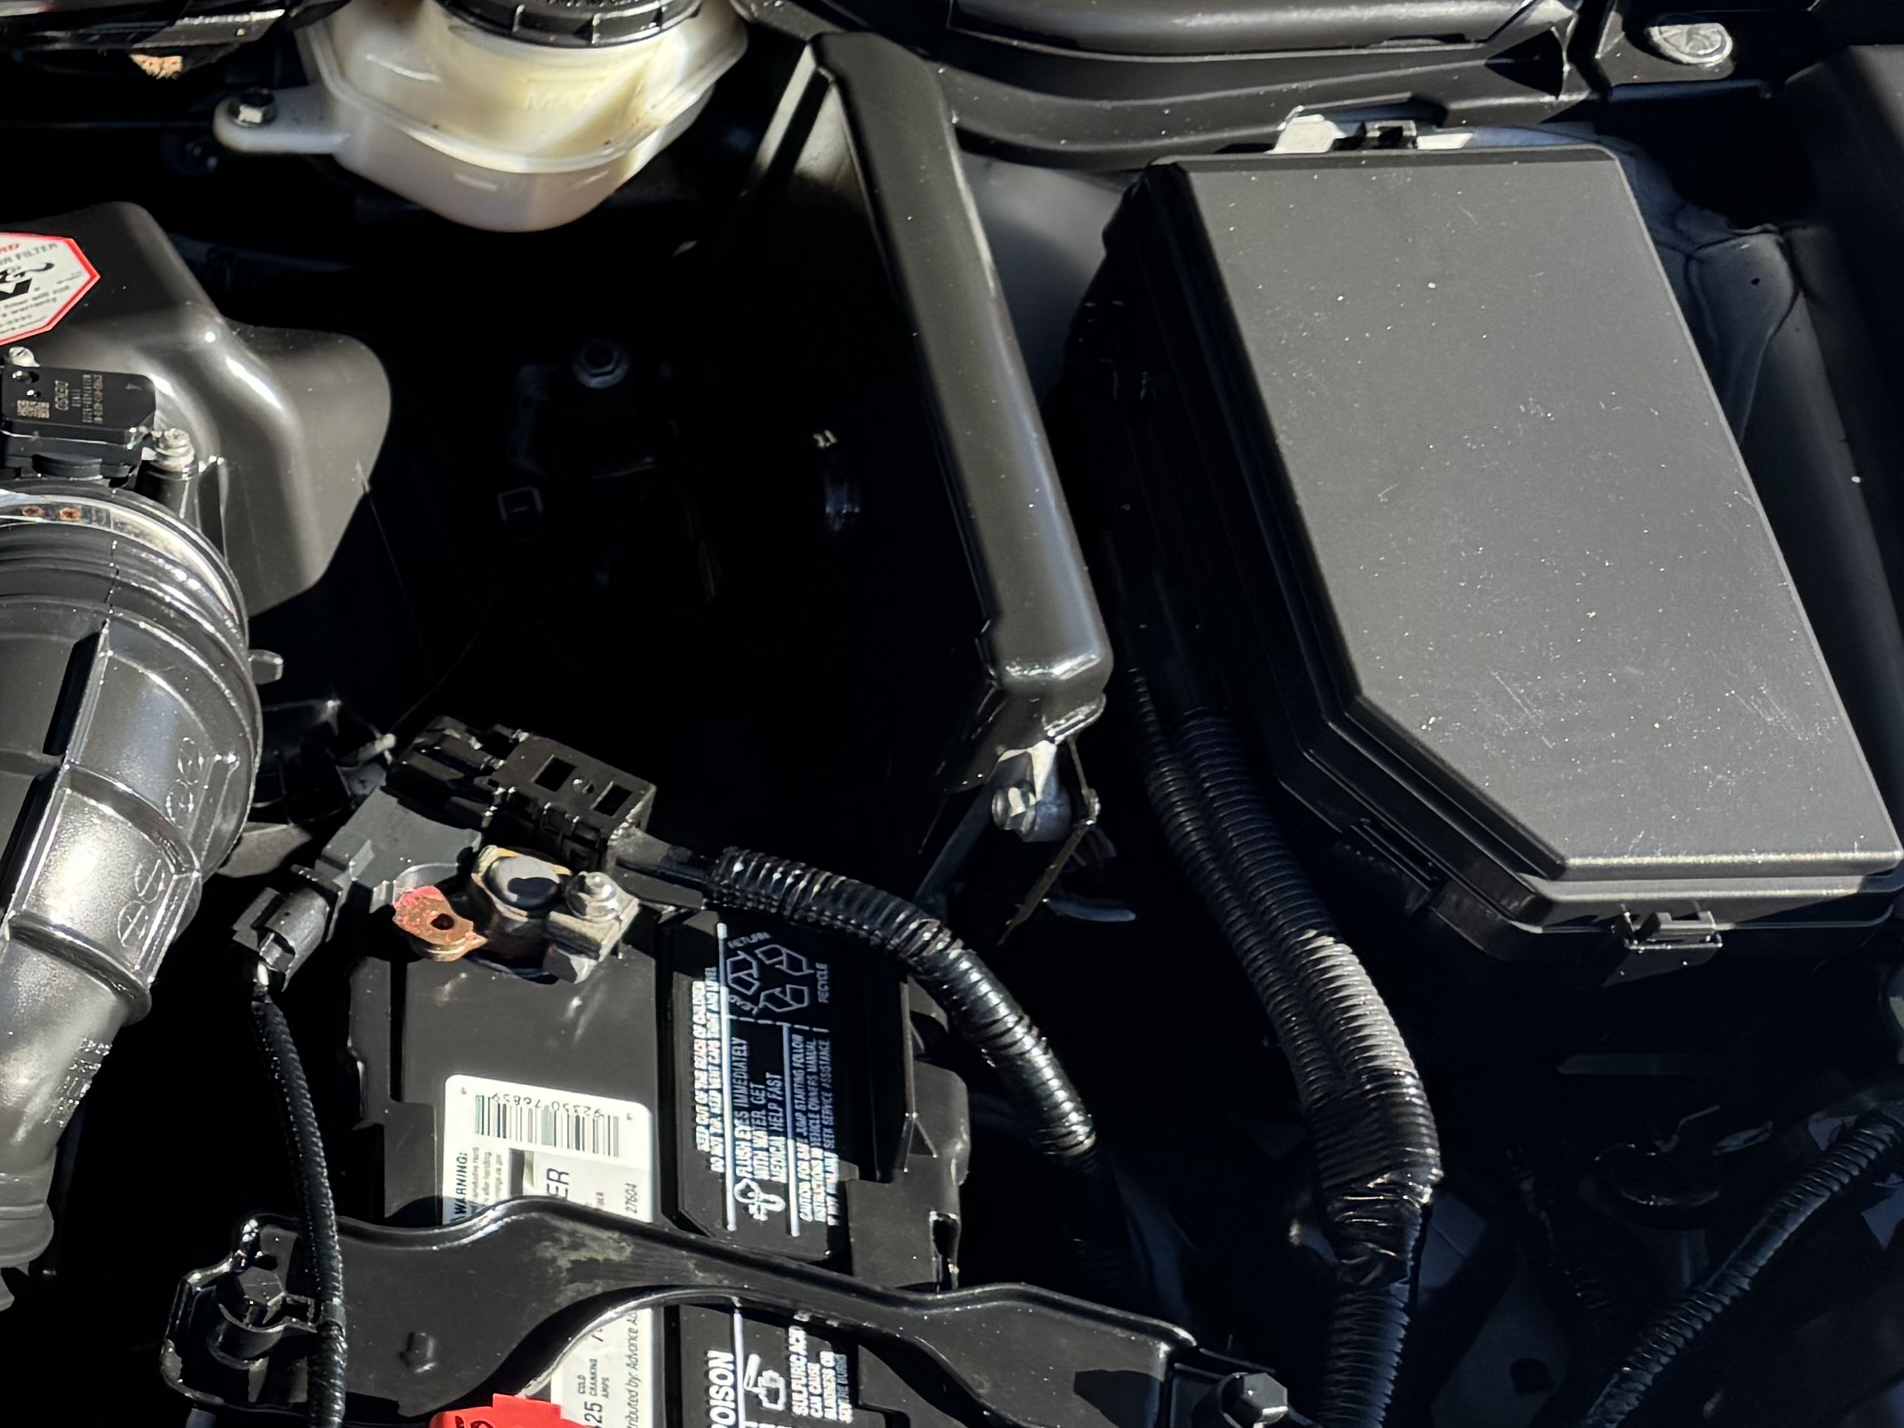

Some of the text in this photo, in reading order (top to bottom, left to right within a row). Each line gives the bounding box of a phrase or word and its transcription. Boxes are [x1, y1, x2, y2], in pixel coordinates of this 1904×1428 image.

[815, 962, 830, 1004] RECYCLE
[792, 1034, 805, 1069] FOLLOW
[731, 1037, 752, 1178] FLUSH EYES IMMEDIATELY
[751, 1084, 765, 1104] GET
[794, 1070, 807, 1111] STARTING
[820, 1090, 833, 1126] SERVICE
[767, 1072, 787, 1183] MEDICAL HELP FAST
[809, 1113, 823, 1146] VEHICLE
[822, 1127, 835, 1149] SEEK
[454, 1152, 468, 1215] WARNING:
[753, 1150, 769, 1180] WITH
[625, 1328, 639, 1370] Advance
[789, 1328, 810, 1416] SULFURIC ACID
[808, 1362, 824, 1419] CAN CAUSE
